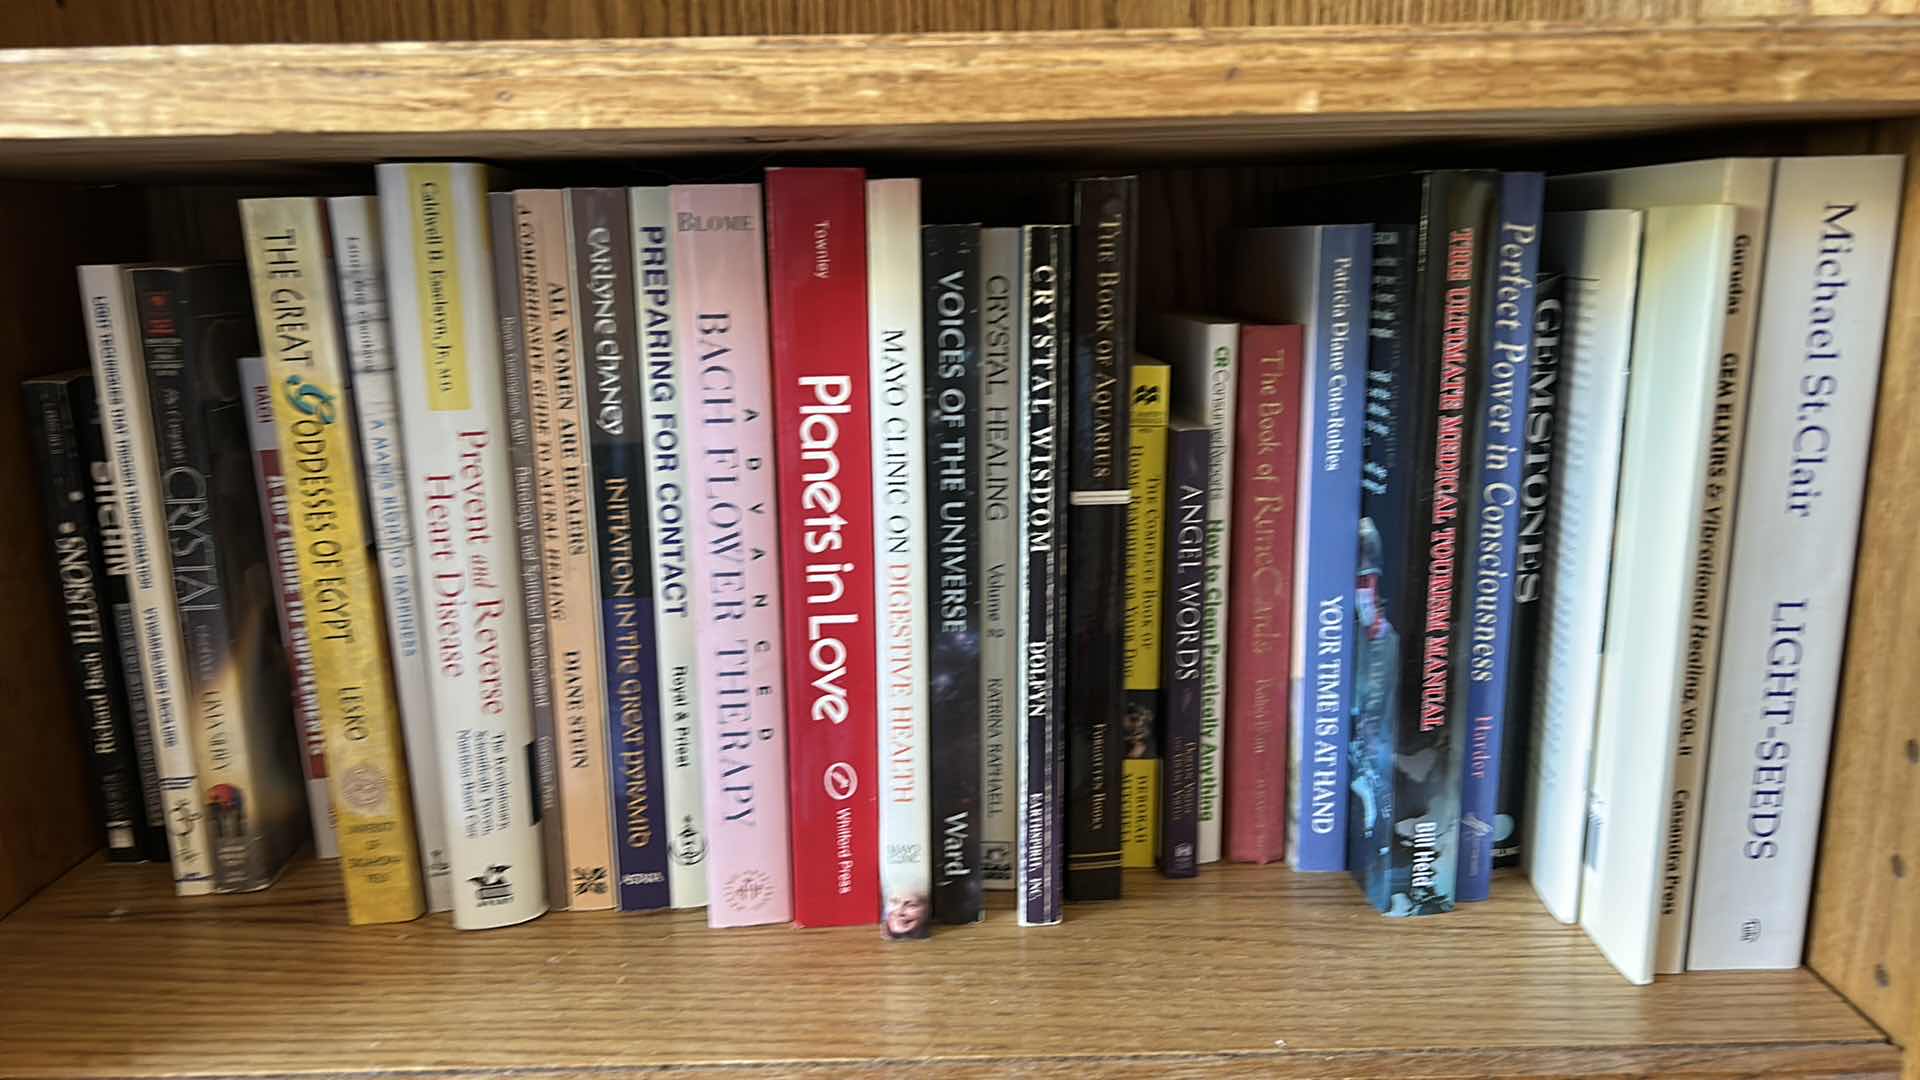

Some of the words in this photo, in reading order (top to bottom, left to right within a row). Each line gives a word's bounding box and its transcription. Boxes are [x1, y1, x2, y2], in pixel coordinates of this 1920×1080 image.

[418, 182, 444, 244] Caldwell
[516, 207, 532, 216] A
[260, 229, 301, 278] THE
[812, 221, 832, 280] Townley
[1445, 227, 1475, 281] THE
[1492, 221, 1538, 330] Perfect
[1722, 232, 1752, 315] Gurudas
[1804, 201, 1861, 361] Michael
[517, 223, 546, 374] COMPREHENSIVE
[546, 283, 569, 320] ALL
[640, 226, 675, 402] PREPARING
[1329, 256, 1355, 317] Patricia
[268, 288, 315, 367] GREAT
[935, 271, 965, 379] VOICES
[983, 275, 1012, 395] CRYSTAL
[1027, 265, 1056, 415] CRYSTAL
[1212, 346, 1230, 368] CR
[1327, 322, 1351, 371] Diane
[1436, 287, 1471, 410] ULTIMATE
[550, 328, 575, 411] WOMEN
[695, 312, 735, 425] BACH
[880, 328, 908, 407] MAYO
[1258, 350, 1285, 395] The
[1485, 339, 1529, 434] Power
[1714, 350, 1741, 397] GEM
[530, 380, 551, 434] GUIDE
[557, 419, 580, 458] ARE
[937, 388, 966, 427] OF
[1256, 400, 1283, 454] Book
[1321, 373, 1349, 471] Cota-Robles
[1705, 402, 1734, 477] ELIXIRS
[537, 442, 554, 463] TO
[651, 414, 679, 471] FOR
[796, 375, 856, 555] Planets
[882, 417, 910, 505] CLINIC
[938, 437, 966, 491] THE
[983, 407, 1010, 522] HEALING
[1251, 462, 1281, 482] of
[1430, 415, 1464, 524] MEDICAL
[1482, 442, 1518, 471] in
[1512, 298, 1562, 604] GEMSTONES
[422, 474, 463, 561] Heart
[453, 430, 498, 545] Prevent
[511, 465, 535, 531] Astrology
[536, 468, 560, 543] NATURAL
[560, 466, 588, 559] HEALERS
[1027, 424, 1053, 553] WISDOM
[1704, 482, 1725, 499] &
[158, 467, 223, 616] CRYSTAL
[307, 539, 344, 569] OF
[518, 535, 538, 560] and
[602, 477, 636, 596] INITIATION
[655, 483, 688, 617] CONTACT
[703, 445, 746, 622] FLOWER
[885, 515, 911, 553] ON
[1176, 485, 1204, 574] ANGEL
[1203, 519, 1225, 558] How
[1689, 505, 1724, 618] Vibrational
[54, 537, 103, 643] ILLUSIONS
[467, 555, 495, 588] and
[521, 563, 542, 619] Spiritual
[544, 547, 567, 625] HEALING
[804, 562, 855, 602] in
[937, 502, 968, 632] UNIVERSE
[984, 563, 1008, 619] Volume
[1203, 565, 1222, 584] to
[1423, 526, 1456, 630] TOURISM
[1466, 481, 1518, 681] Consciousness
[311, 577, 354, 643] EGYPT
[430, 573, 473, 677] Disease
[612, 602, 636, 627] IN
[886, 561, 914, 697] DIGESTIVE
[1174, 581, 1201, 681] WORDS
[1200, 588, 1222, 640] Clean
[1316, 594, 1344, 654] YOUR
[78, 652, 106, 689] Bach
[468, 597, 513, 713] Reverse
[526, 623, 548, 707] Development
[561, 649, 586, 710] DIANE
[668, 663, 690, 706] Royal
[806, 612, 861, 723] Love
[1025, 640, 1046, 717] DOLFYN
[1314, 659, 1342, 711] TIME
[1417, 635, 1449, 731] MANUAL
[86, 694, 117, 752] Richard
[336, 685, 372, 742] LESKO
[616, 679, 644, 743] GREAT
[672, 711, 689, 722] &
[984, 676, 1004, 736] KATRINA
[1196, 642, 1222, 738] Practically
[490, 731, 507, 752] The
[566, 713, 589, 768] STEIN
[672, 726, 693, 767] Priest
[711, 640, 758, 827] THERAPY
[888, 704, 915, 804] HEALTH
[1311, 740, 1337, 765] AT
[1313, 716, 1338, 735] IS
[1741, 594, 1811, 862] LIGHT-SEEDS
[620, 750, 651, 847] PYRAMID
[983, 743, 1005, 818] RAPHAELL
[1193, 742, 1219, 823] Anything
[1309, 769, 1337, 834] HAND
[832, 807, 852, 853] Whitford
[941, 810, 971, 876] Ward
[1412, 820, 1439, 844] Bill
[1663, 784, 1693, 867] Cassandra
[834, 858, 852, 893] Press
[1658, 870, 1683, 912] Press
